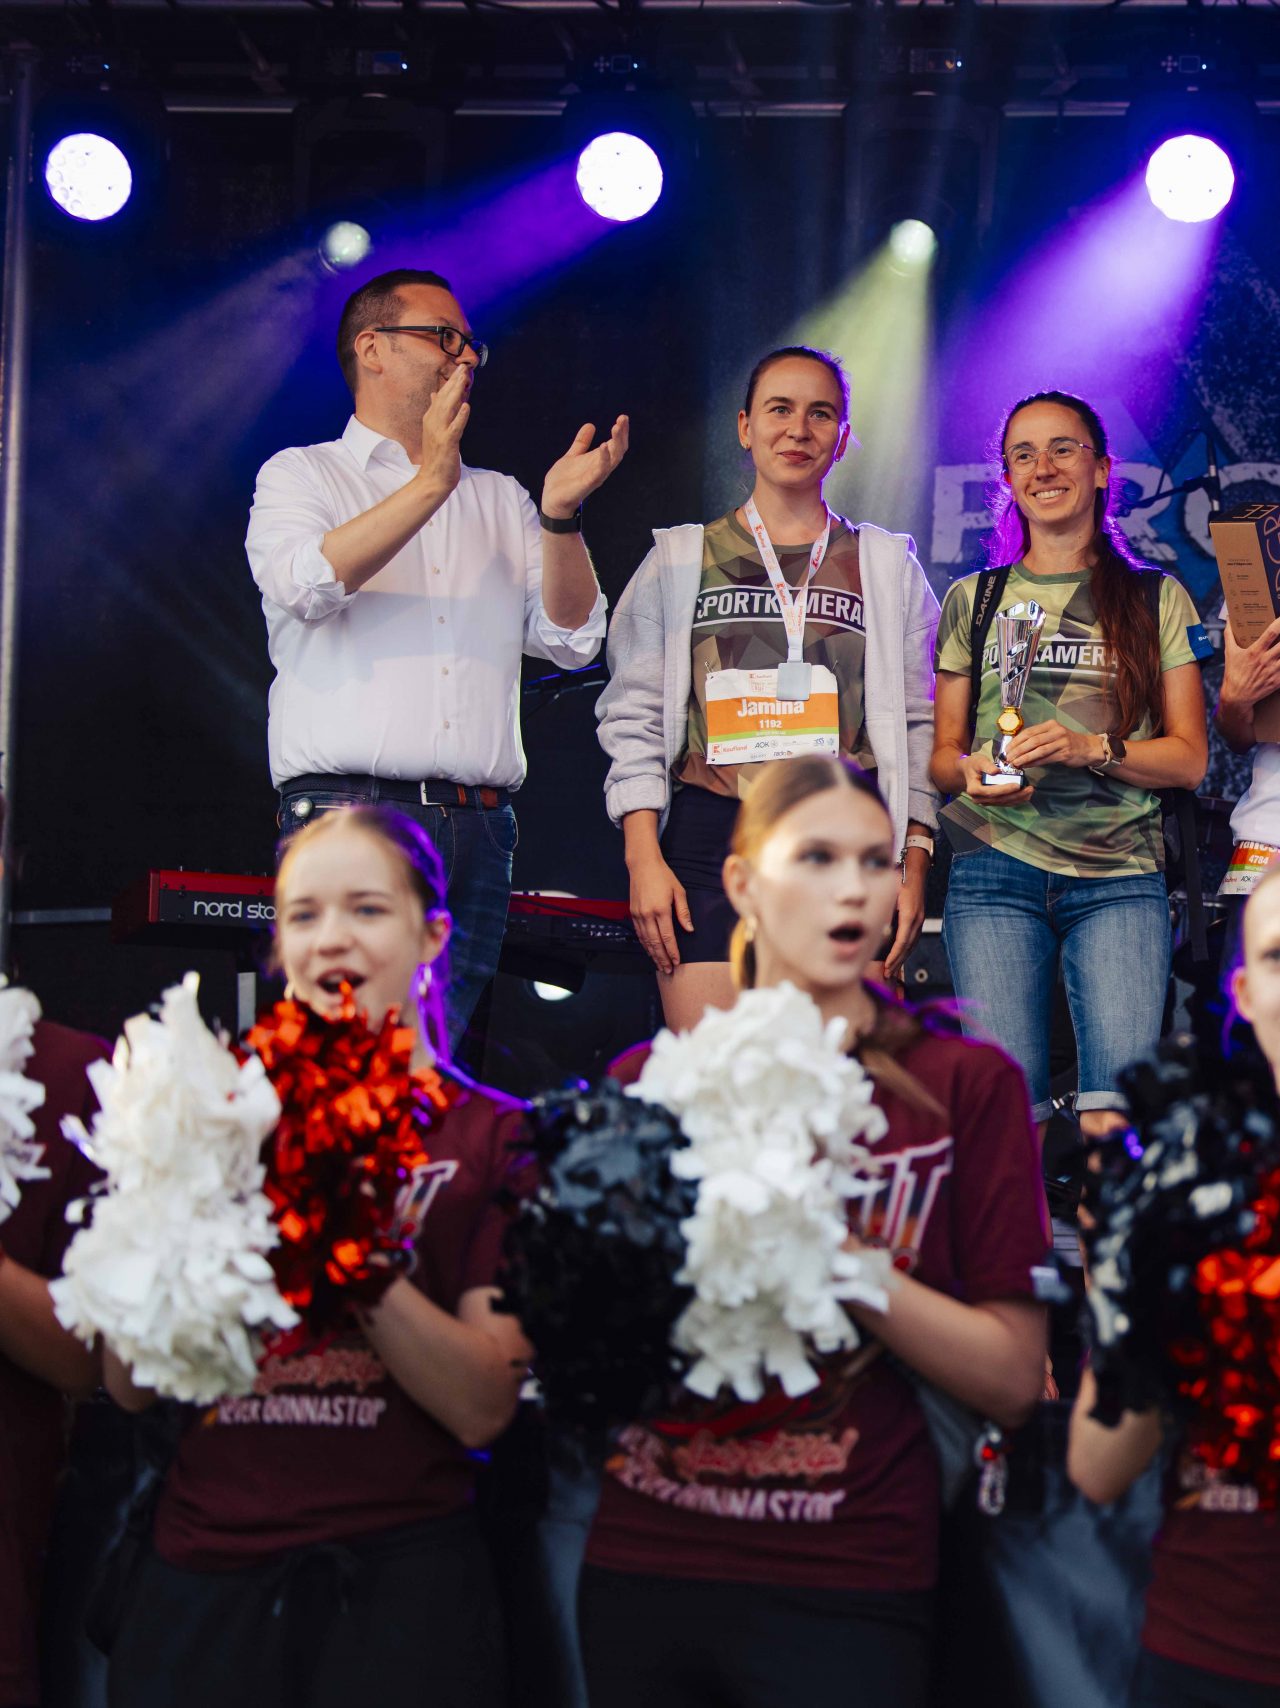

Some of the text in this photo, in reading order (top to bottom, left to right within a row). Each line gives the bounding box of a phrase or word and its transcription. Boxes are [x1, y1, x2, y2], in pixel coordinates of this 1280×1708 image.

[975, 575, 997, 627] DAKINE
[737, 697, 805, 718] Jamina
[759, 719, 782, 729] 1192
[754, 741, 770, 749] AOK
[1248, 854, 1270, 865] 4784
[193, 900, 277, 920] nord sta
